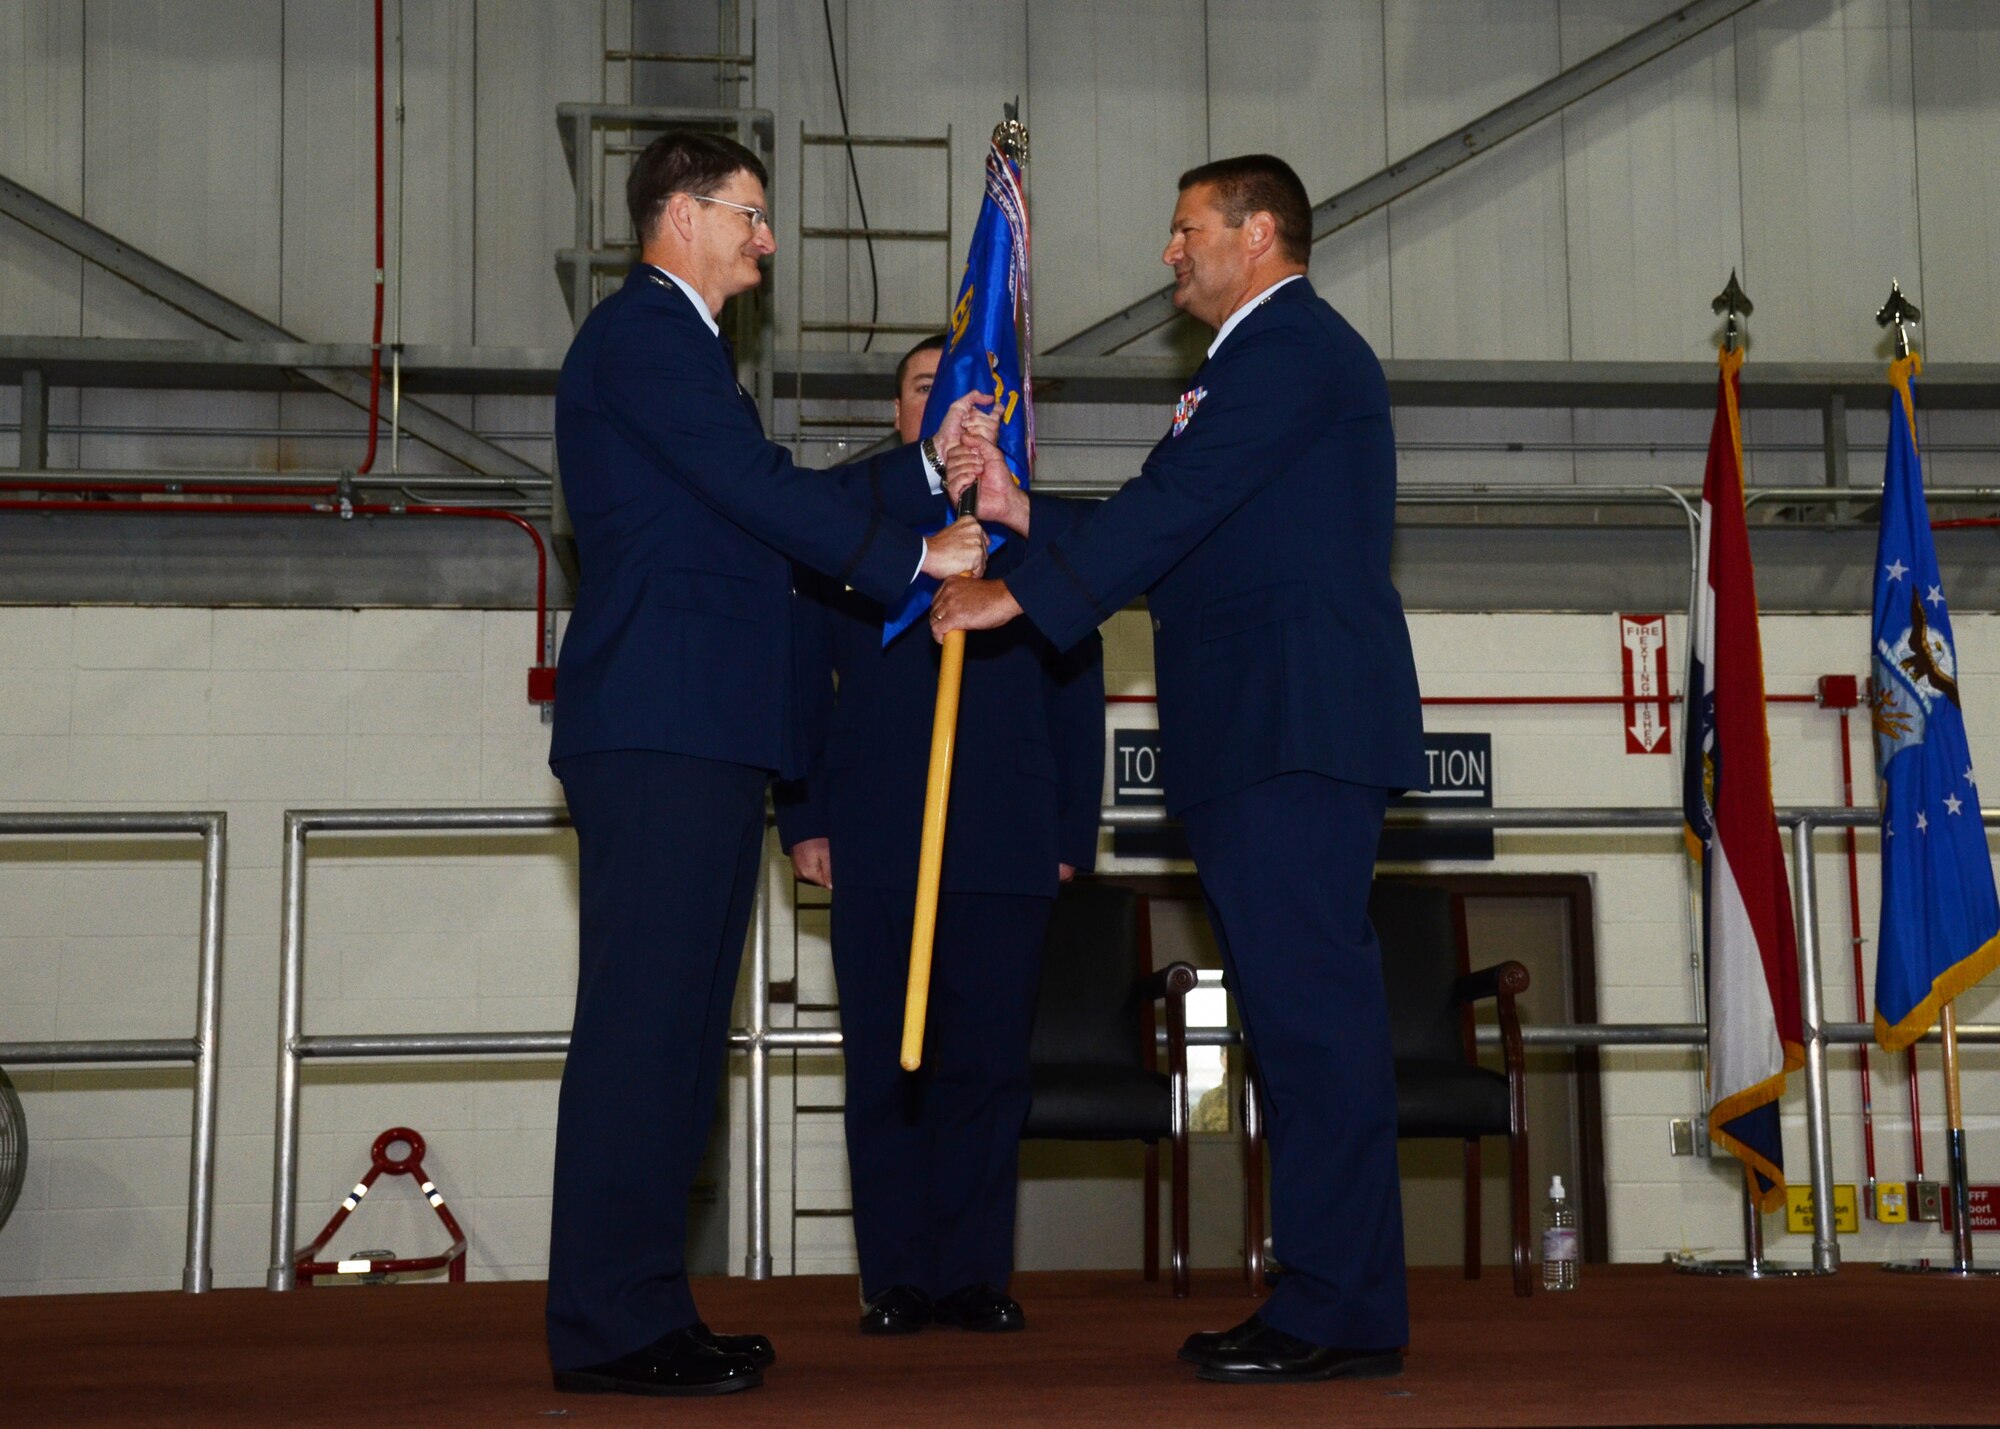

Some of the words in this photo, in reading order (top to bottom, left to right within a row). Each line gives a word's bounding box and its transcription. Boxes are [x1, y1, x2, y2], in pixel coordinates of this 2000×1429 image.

[1626, 626, 1659, 636] FIRE
[1119, 746, 1161, 783] TO
[1424, 749, 1485, 786] TION
[1968, 1191, 1989, 1201] FFF
[1970, 1216, 1997, 1226] ation
